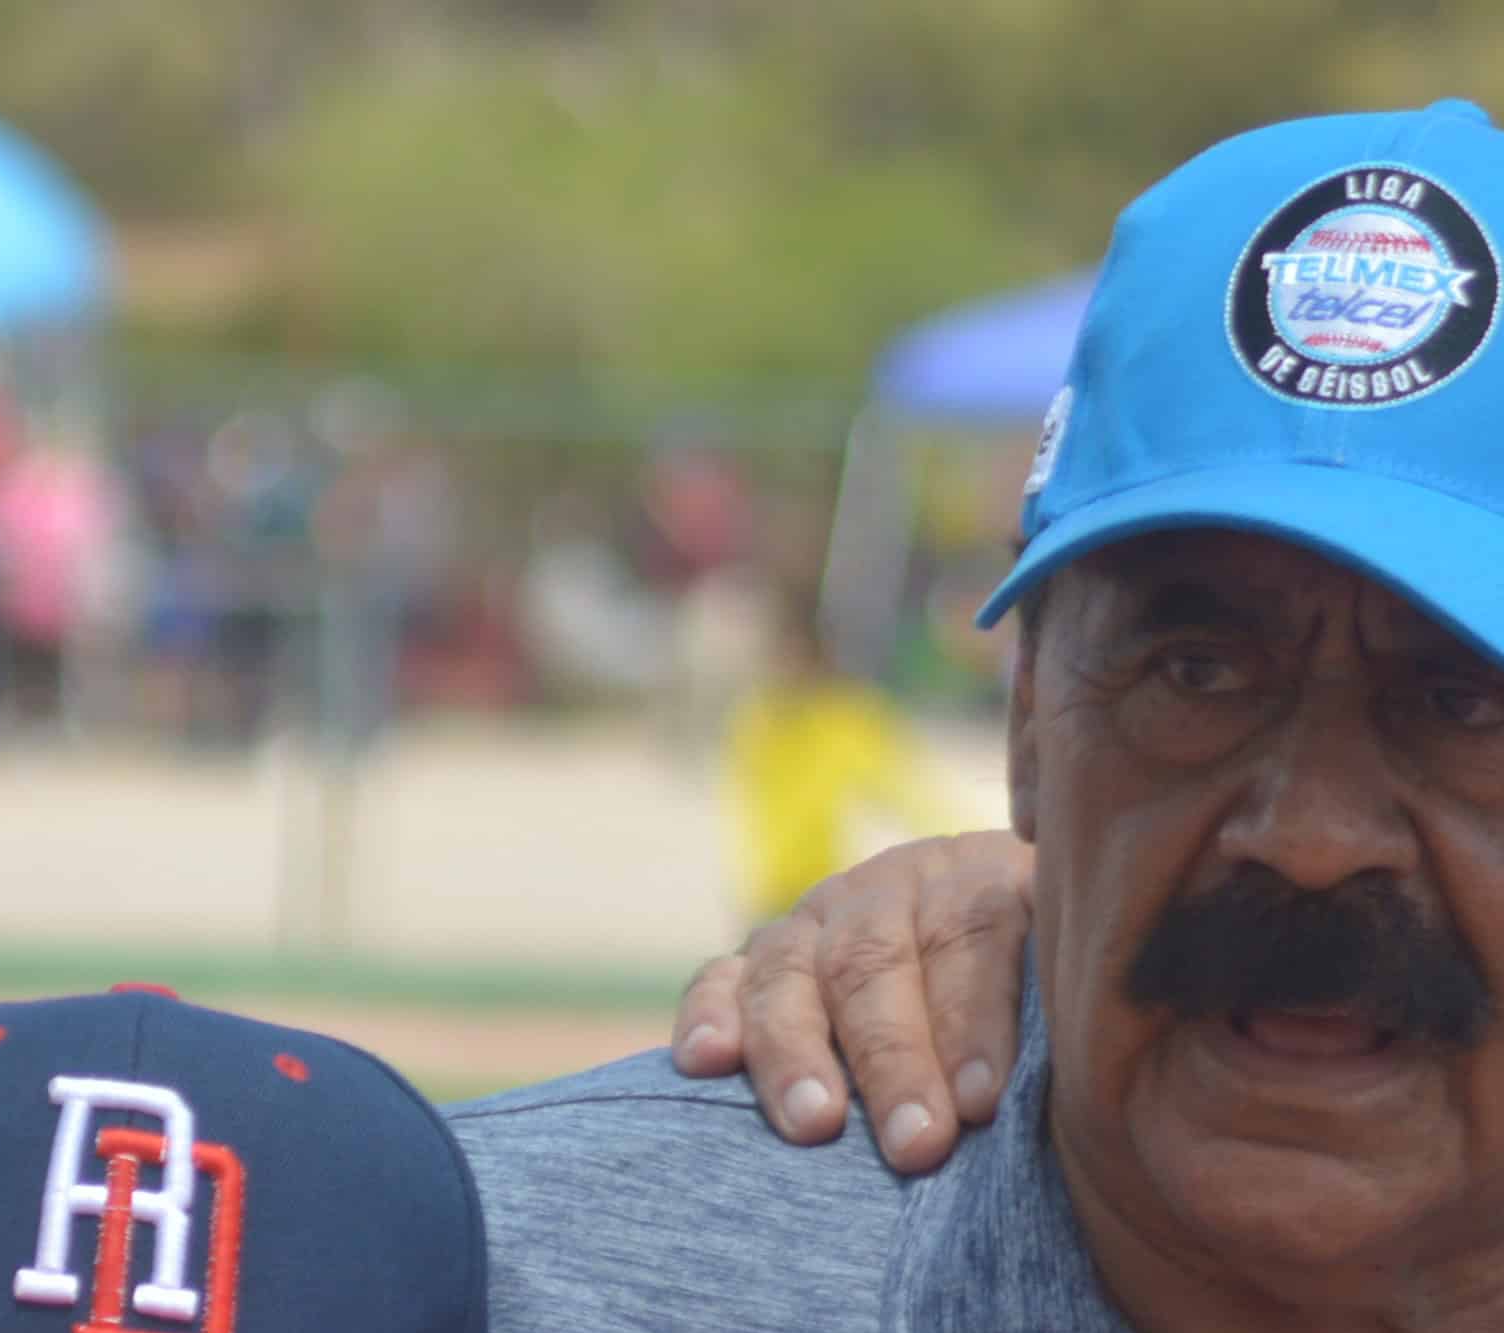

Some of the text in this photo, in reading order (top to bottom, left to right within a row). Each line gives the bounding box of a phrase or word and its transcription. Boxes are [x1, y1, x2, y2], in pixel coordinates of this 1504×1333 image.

[1346, 173, 1424, 209] LIGA
[1261, 252, 1476, 307] TELMEX
[1289, 288, 1434, 329] telcel
[1258, 345, 1433, 400] DE BÉISBOL
